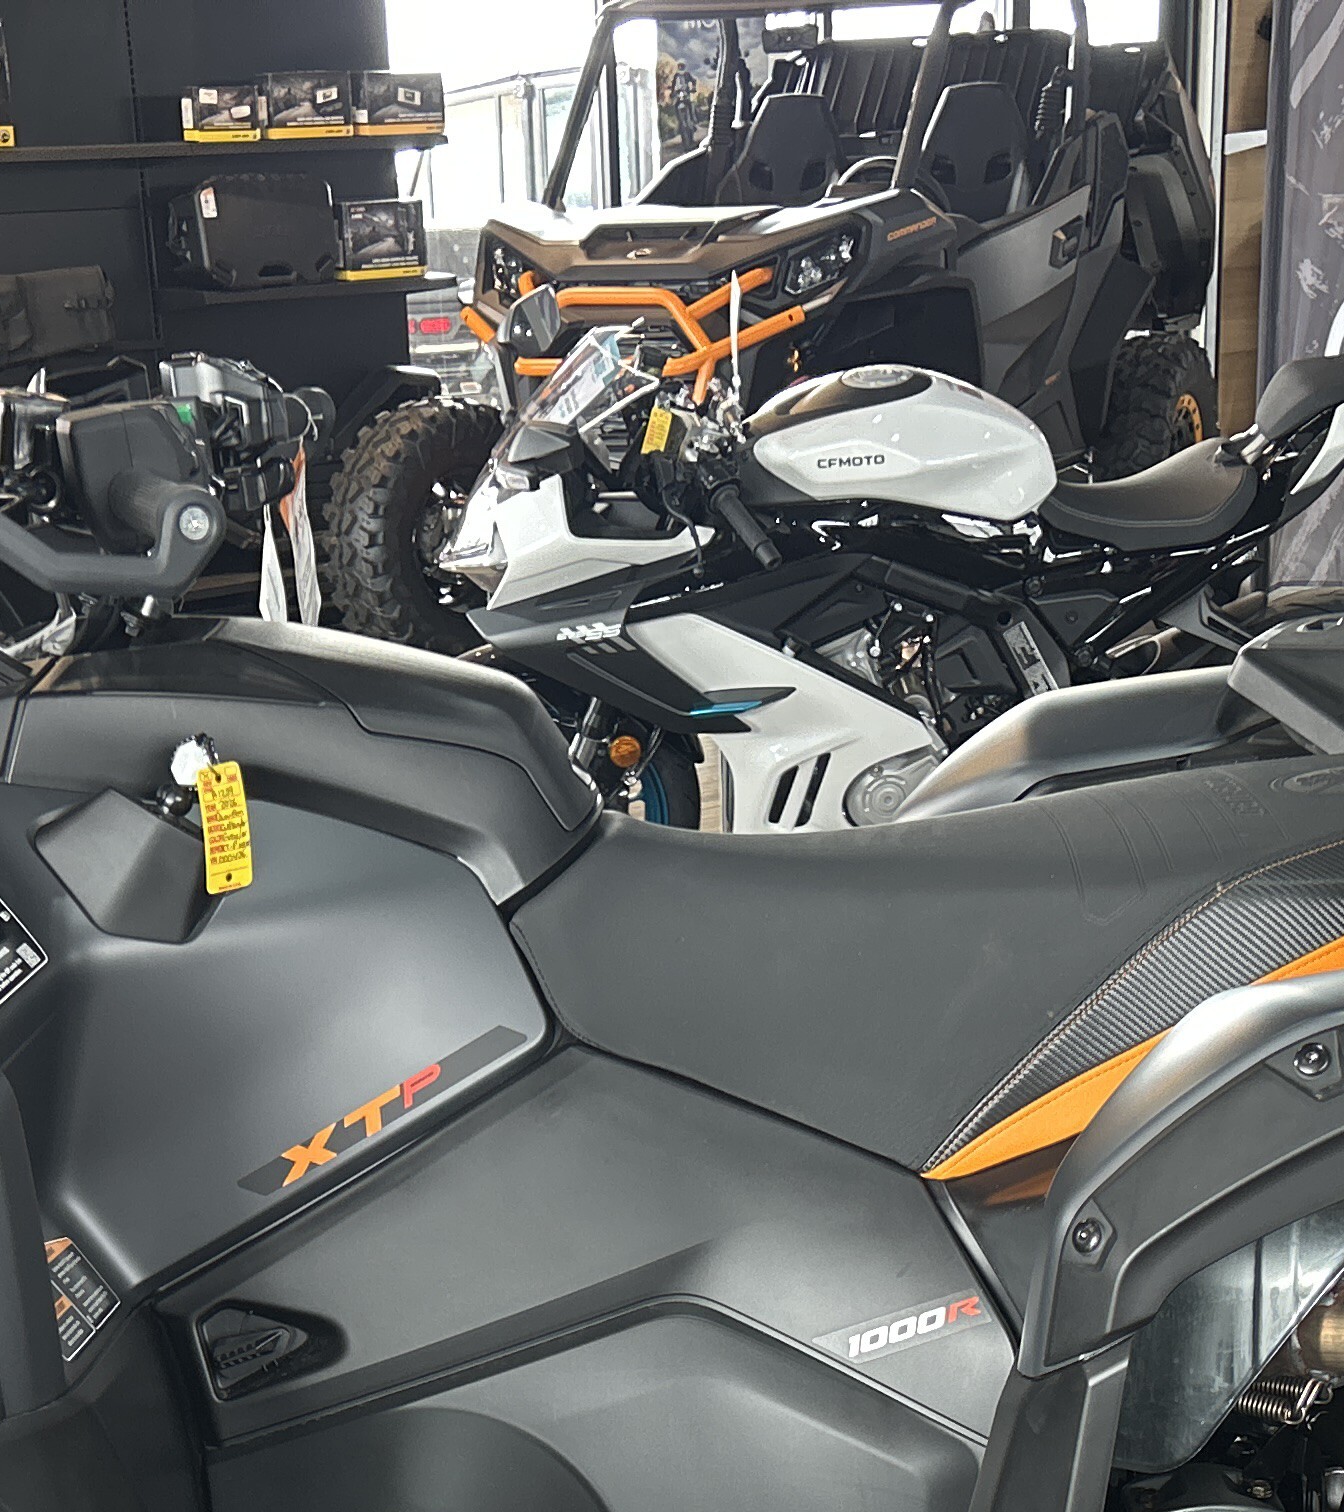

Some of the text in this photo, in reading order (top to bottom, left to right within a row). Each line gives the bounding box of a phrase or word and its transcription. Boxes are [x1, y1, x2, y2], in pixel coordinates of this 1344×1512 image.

[886, 216, 937, 241] COMMANDER
[817, 454, 885, 469] CFMOTO
[280, 1063, 441, 1188] XTP
[848, 1296, 982, 1358] 1000R
